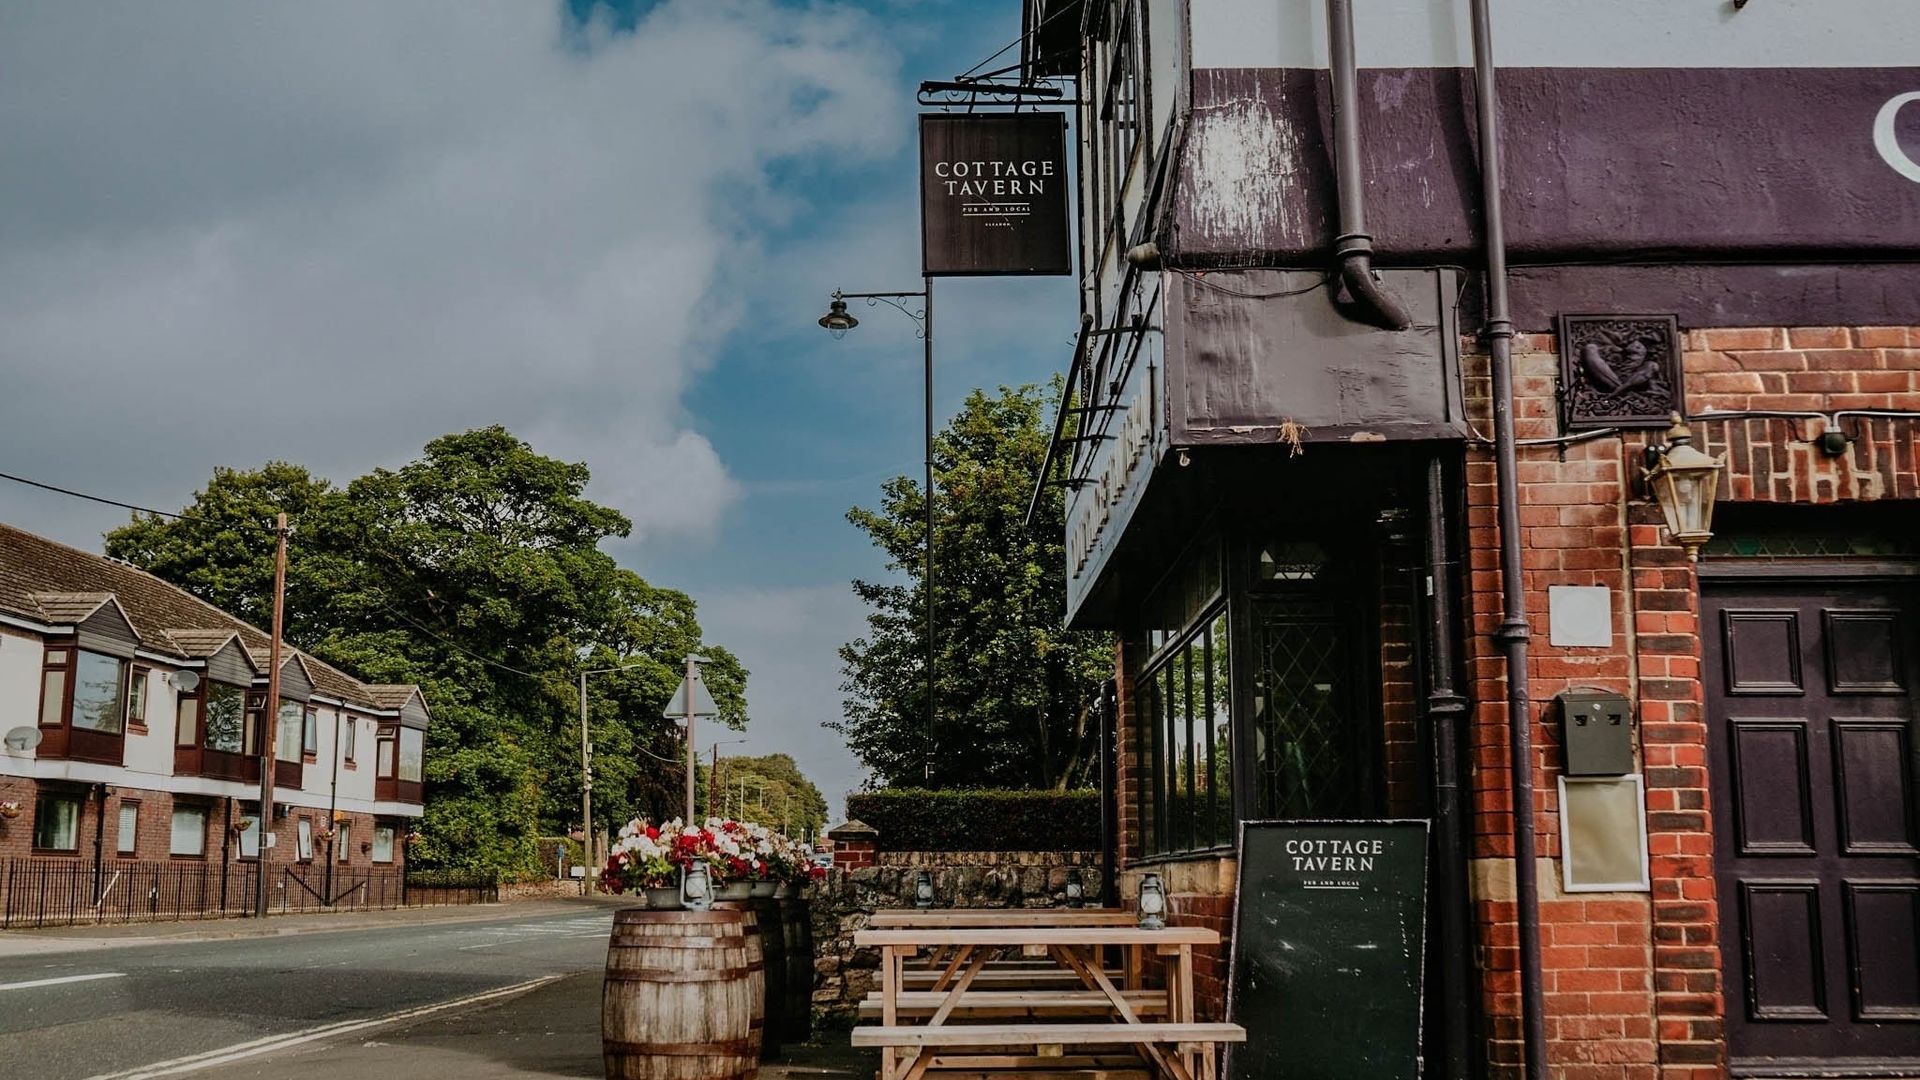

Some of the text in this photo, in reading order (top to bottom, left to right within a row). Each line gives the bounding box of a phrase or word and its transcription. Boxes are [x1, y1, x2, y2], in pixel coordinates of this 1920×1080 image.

[935, 161, 1054, 177] COTTAGE
[944, 180, 1044, 195] TAVERN
[1285, 839, 1383, 855] COTTAGE
[1292, 856, 1374, 872] TAVERN
